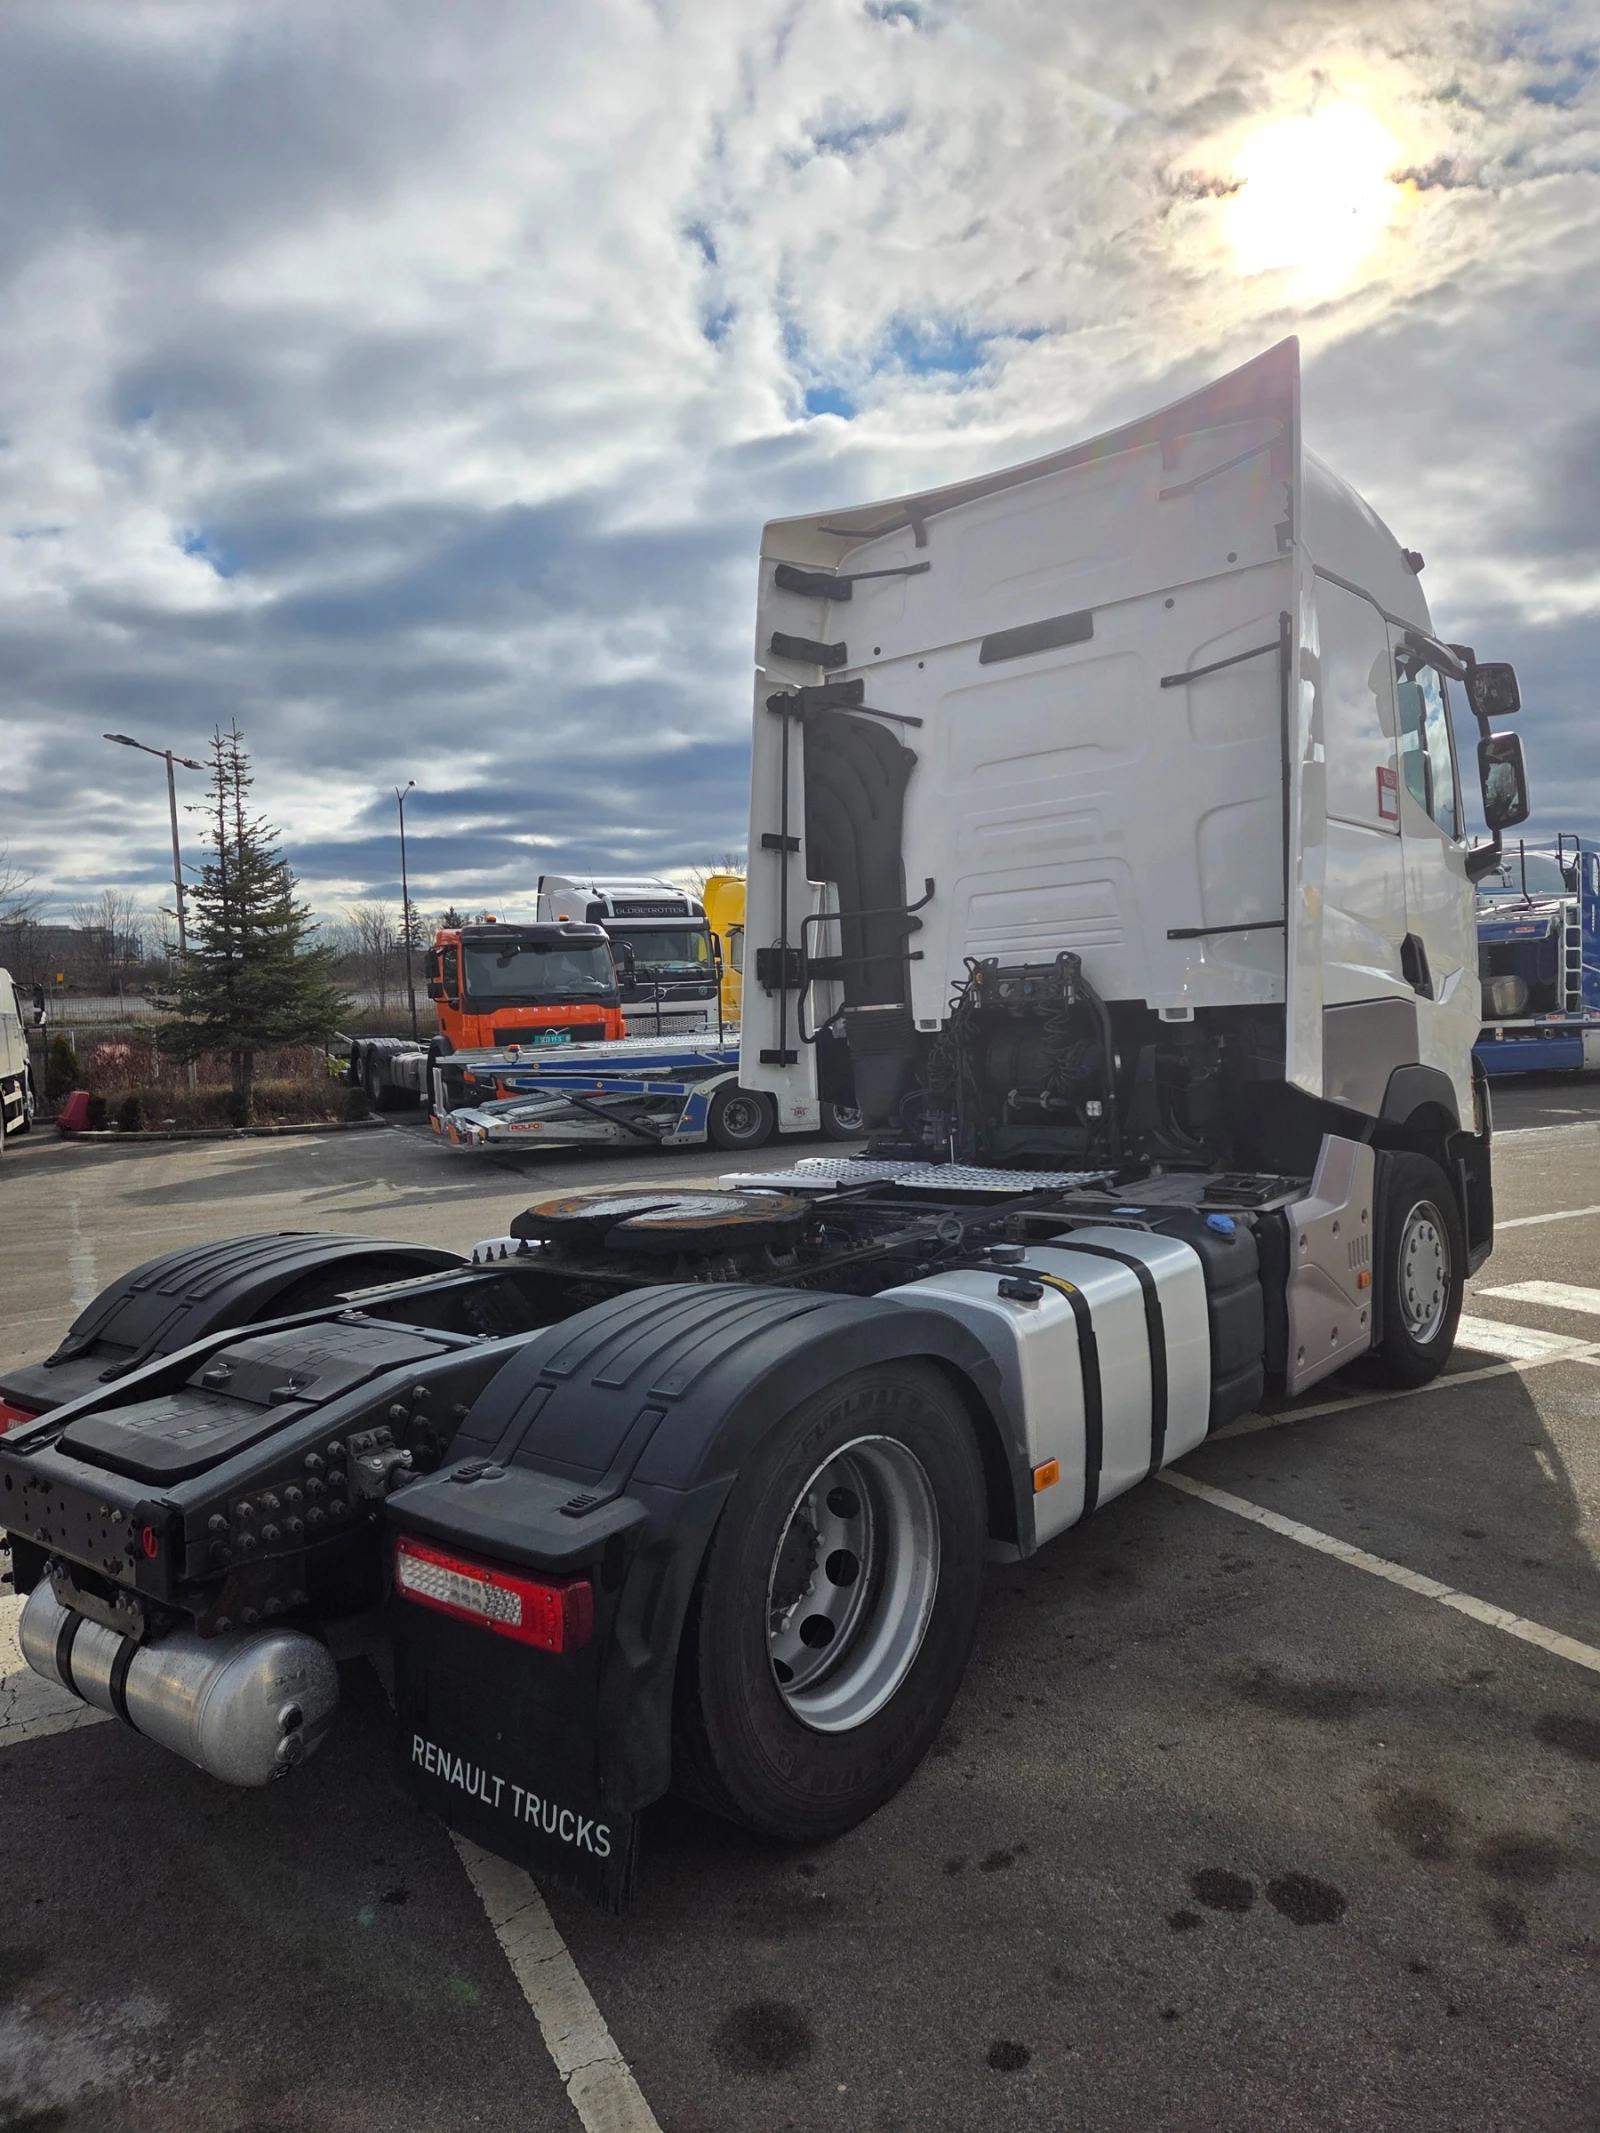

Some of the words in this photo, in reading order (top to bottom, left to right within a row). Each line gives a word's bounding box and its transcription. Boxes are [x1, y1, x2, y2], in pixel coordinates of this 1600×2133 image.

[616, 906, 685, 914] GLOBETROTTER
[412, 1734, 505, 1807] RENAULT
[511, 1784, 610, 1857] TRUCKS
